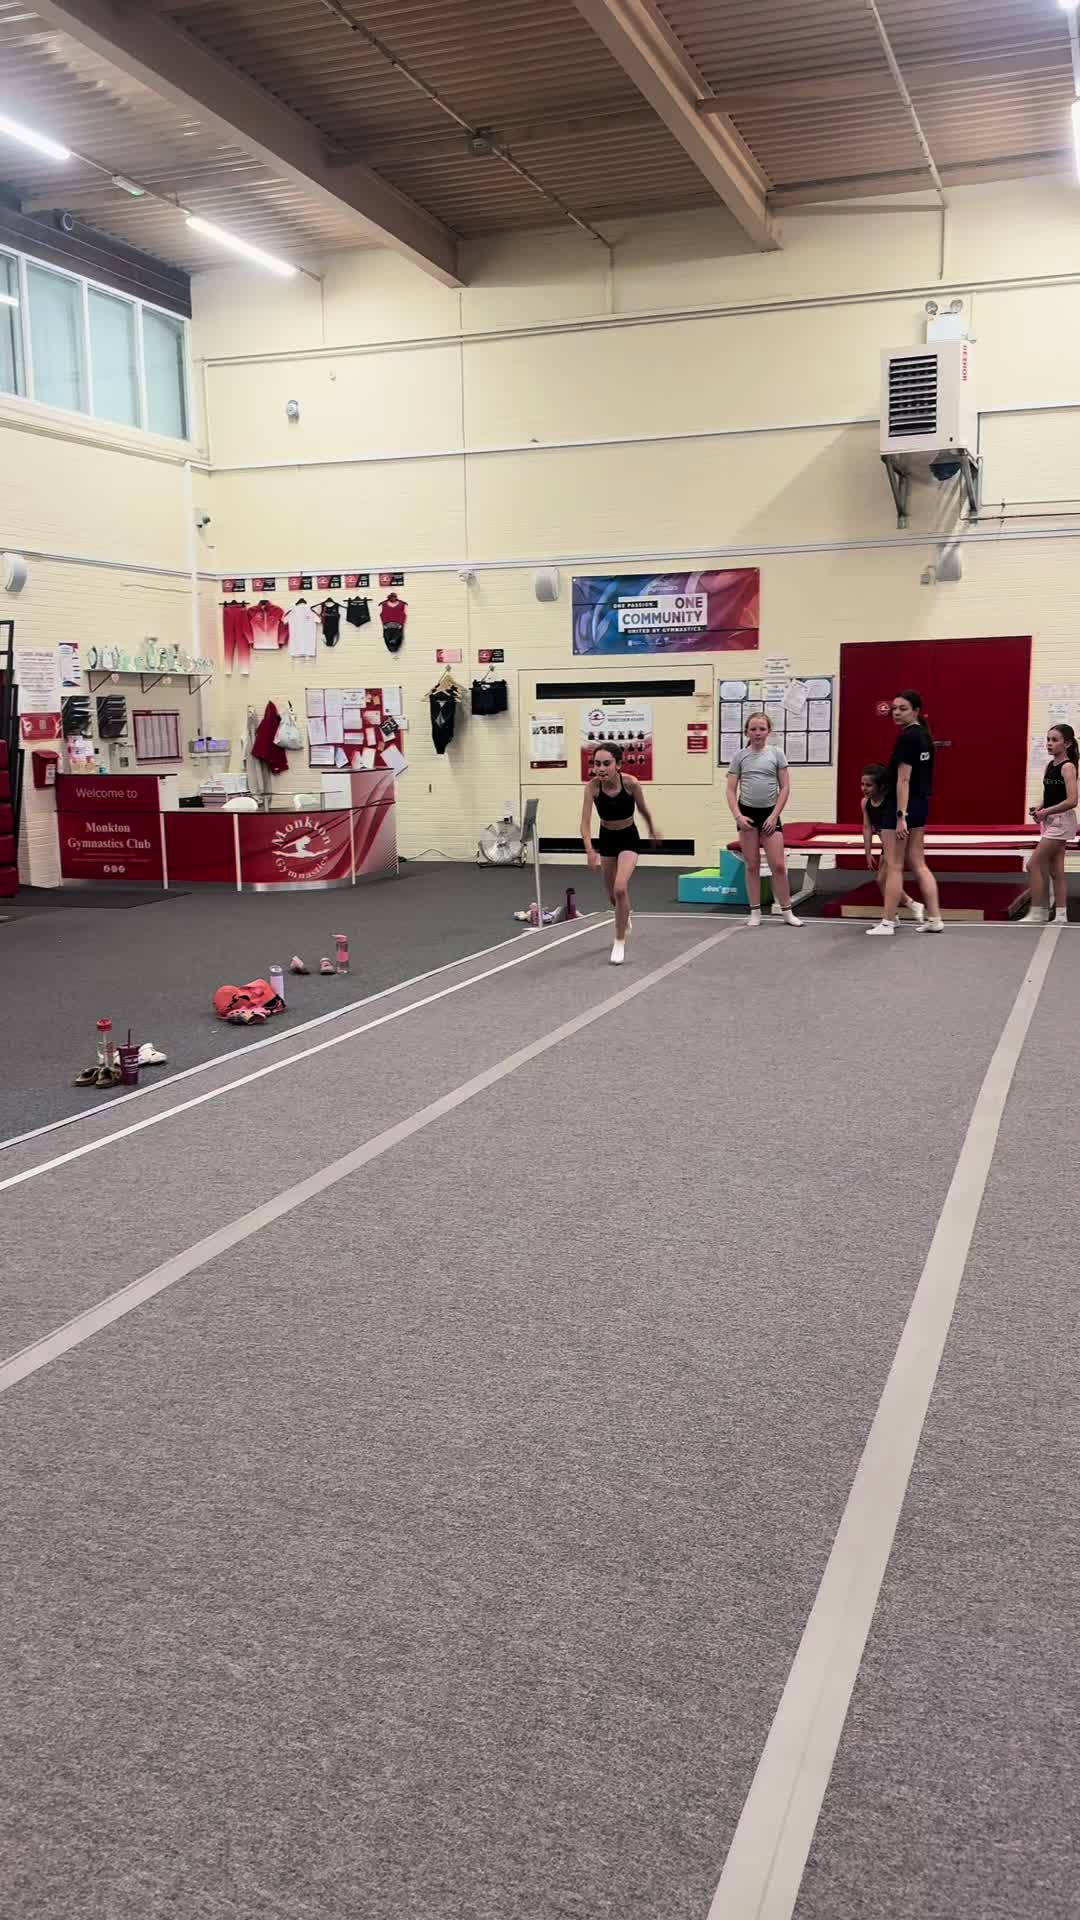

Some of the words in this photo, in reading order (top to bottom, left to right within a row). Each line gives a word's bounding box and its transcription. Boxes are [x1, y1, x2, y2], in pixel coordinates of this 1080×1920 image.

[674, 597, 703, 608] ONE
[622, 611, 703, 625] COMMUNITY
[76, 787, 124, 798] Welcome
[126, 789, 138, 798] to
[85, 822, 130, 832] Monkton
[271, 816, 331, 847] Monkton
[67, 837, 124, 850] Gymnastics
[126, 838, 151, 849] Club
